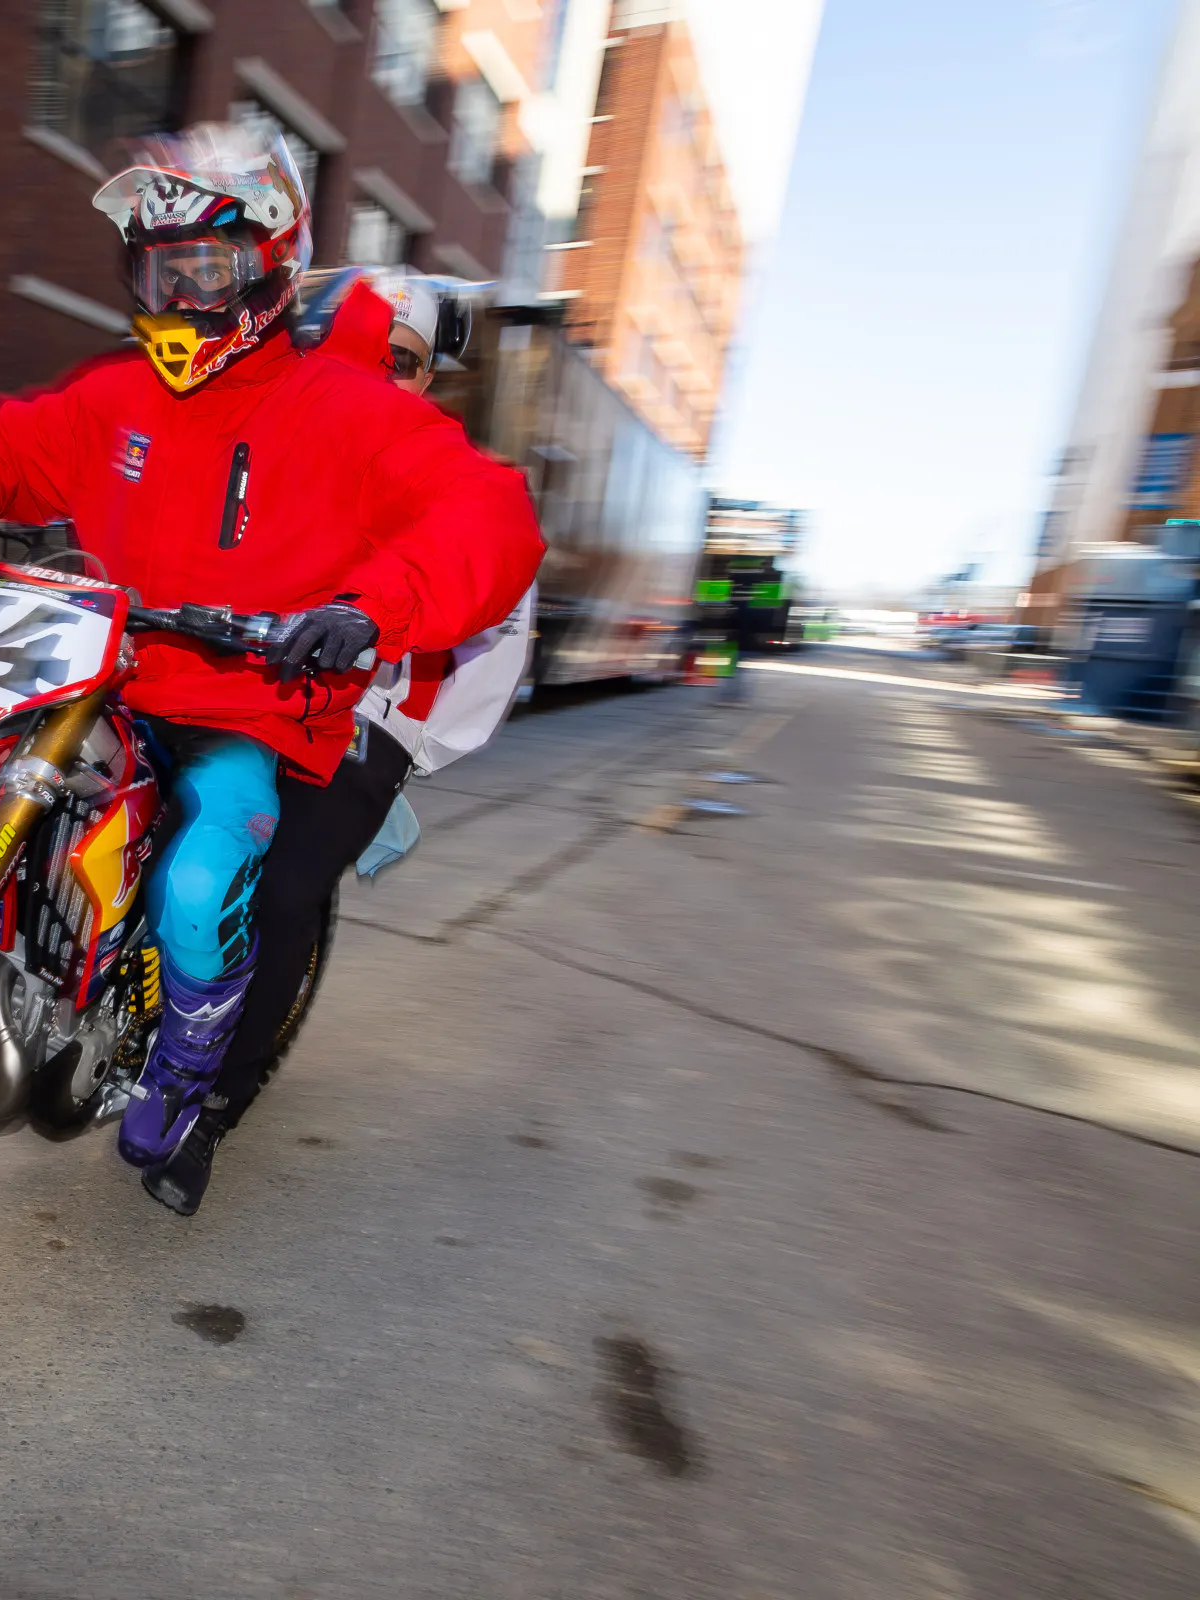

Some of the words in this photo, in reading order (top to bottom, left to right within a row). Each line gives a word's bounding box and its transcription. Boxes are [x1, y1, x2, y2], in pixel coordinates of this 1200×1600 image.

[255, 294, 285, 334] Red
[238, 471, 249, 499] OUTDOOR
[8, 581, 72, 601] SUPERCROSS
[39, 967, 55, 980] Twin
[52, 975, 65, 986] Air
